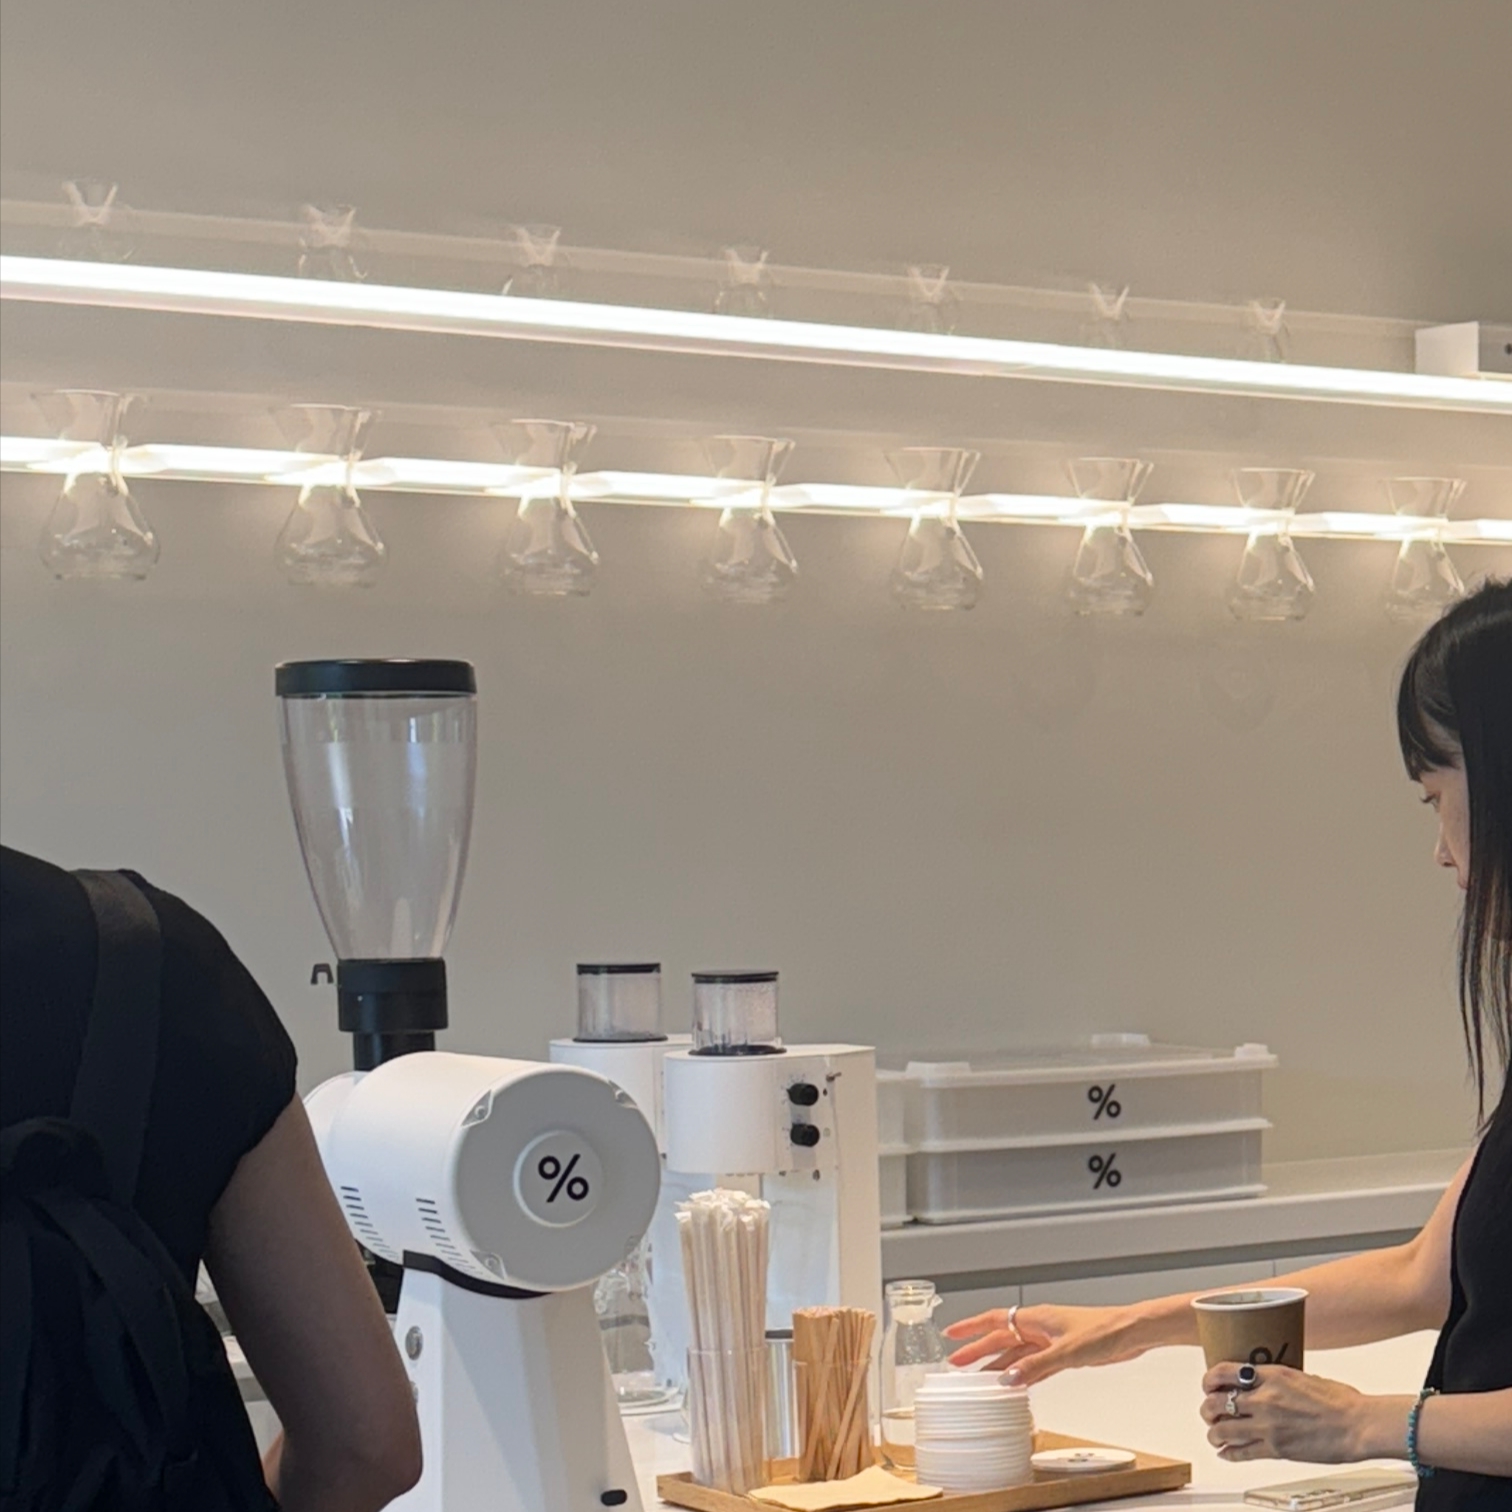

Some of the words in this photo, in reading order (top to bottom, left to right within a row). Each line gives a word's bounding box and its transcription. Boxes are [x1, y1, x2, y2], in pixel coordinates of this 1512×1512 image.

[1088, 1083, 1122, 1120] %
[538, 1153, 589, 1203] %
[1088, 1152, 1122, 1190] %
